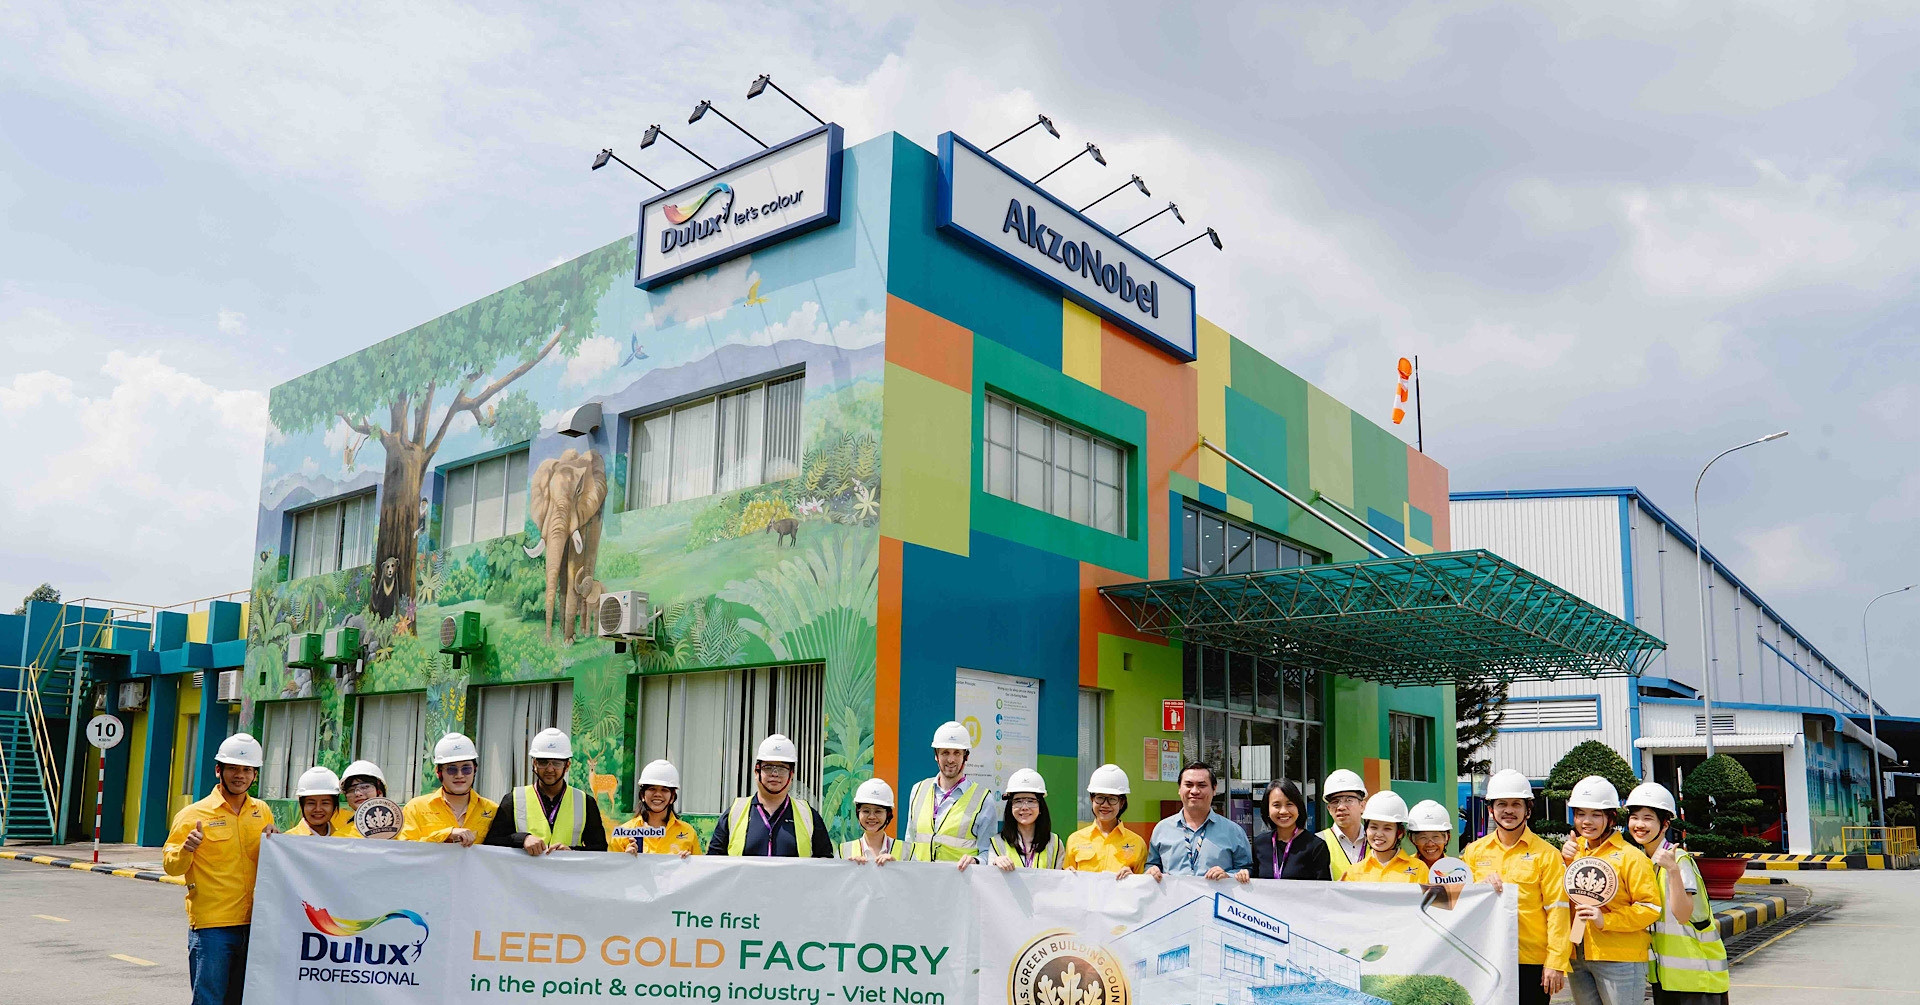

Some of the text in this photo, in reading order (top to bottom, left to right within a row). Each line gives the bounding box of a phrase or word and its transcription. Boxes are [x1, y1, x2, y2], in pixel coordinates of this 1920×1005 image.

[734, 190, 804, 225] let's colour
[661, 214, 722, 253] Dulux
[1003, 198, 1159, 319] AkzoNobel
[95, 722, 116, 737] 10
[613, 828, 665, 836] AkzoNobel
[1434, 876, 1464, 884] Dulux
[1585, 860, 1609, 873] BUILDING
[672, 911, 760, 929] The first
[1227, 905, 1280, 933] AkzoNobel
[300, 931, 410, 966] Dulux
[472, 930, 950, 975] LEED GOLD FACTORY
[298, 967, 420, 986] PROFESSIONAL
[1020, 947, 1048, 986] GREEN
[1050, 941, 1106, 966] BUILDING
[470, 974, 491, 992] in
[498, 975, 536, 993] the
[542, 977, 602, 998] paint
[609, 978, 627, 996] &
[634, 980, 721, 1003] coating
[728, 982, 820, 1005] industry
[842, 985, 887, 1003] Viet
[892, 986, 945, 1005] Nam
